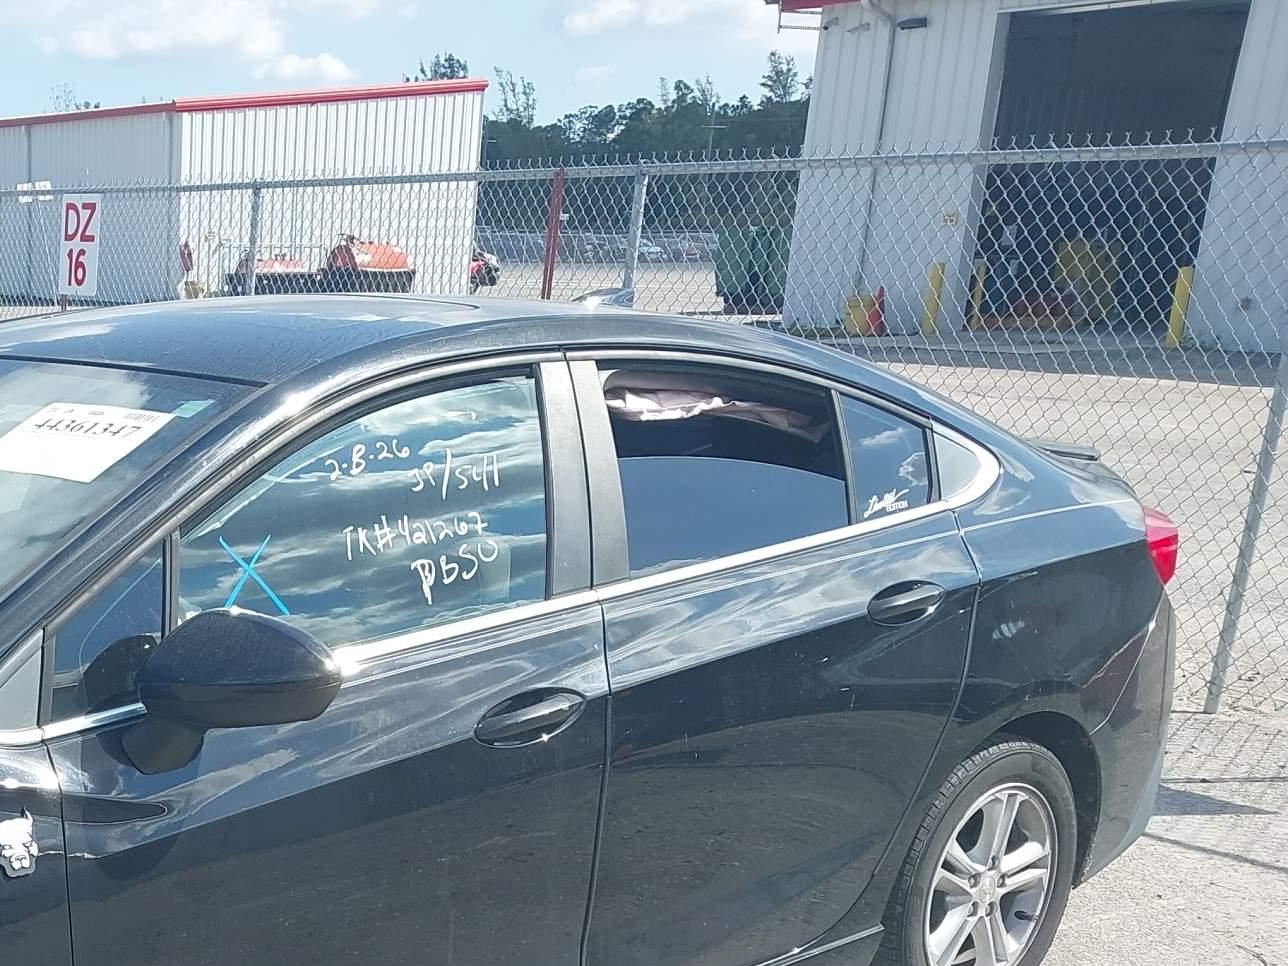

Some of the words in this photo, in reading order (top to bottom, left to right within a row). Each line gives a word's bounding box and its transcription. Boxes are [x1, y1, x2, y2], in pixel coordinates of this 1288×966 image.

[63, 202, 97, 242] DZ
[67, 248, 87, 287] 16
[34, 417, 142, 438] 44361347
